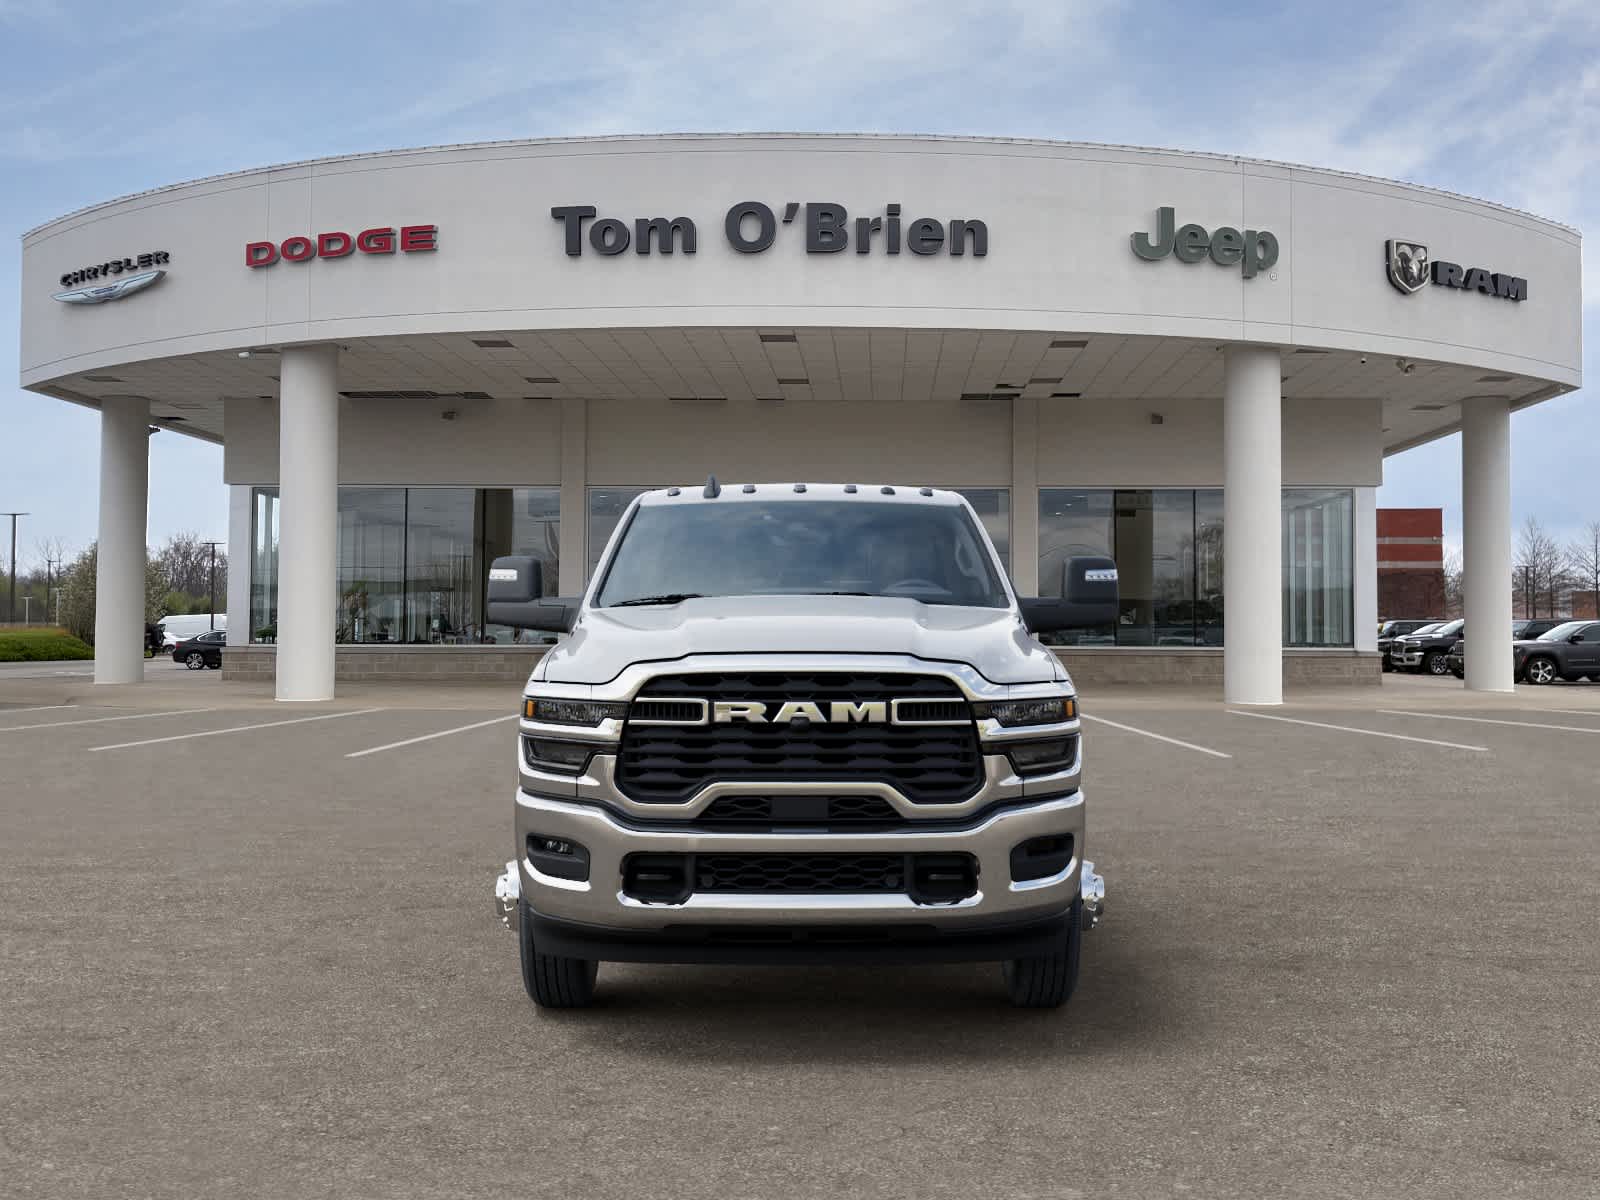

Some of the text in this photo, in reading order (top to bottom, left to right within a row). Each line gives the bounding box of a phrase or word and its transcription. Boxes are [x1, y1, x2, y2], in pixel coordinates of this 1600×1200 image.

[246, 225, 438, 268] DODGE
[551, 201, 988, 256] Tom O'Brien
[1130, 206, 1279, 279] Jeep
[60, 250, 170, 286] CHRYSLER
[1430, 260, 1528, 301] RAM
[713, 701, 887, 723] RAM
